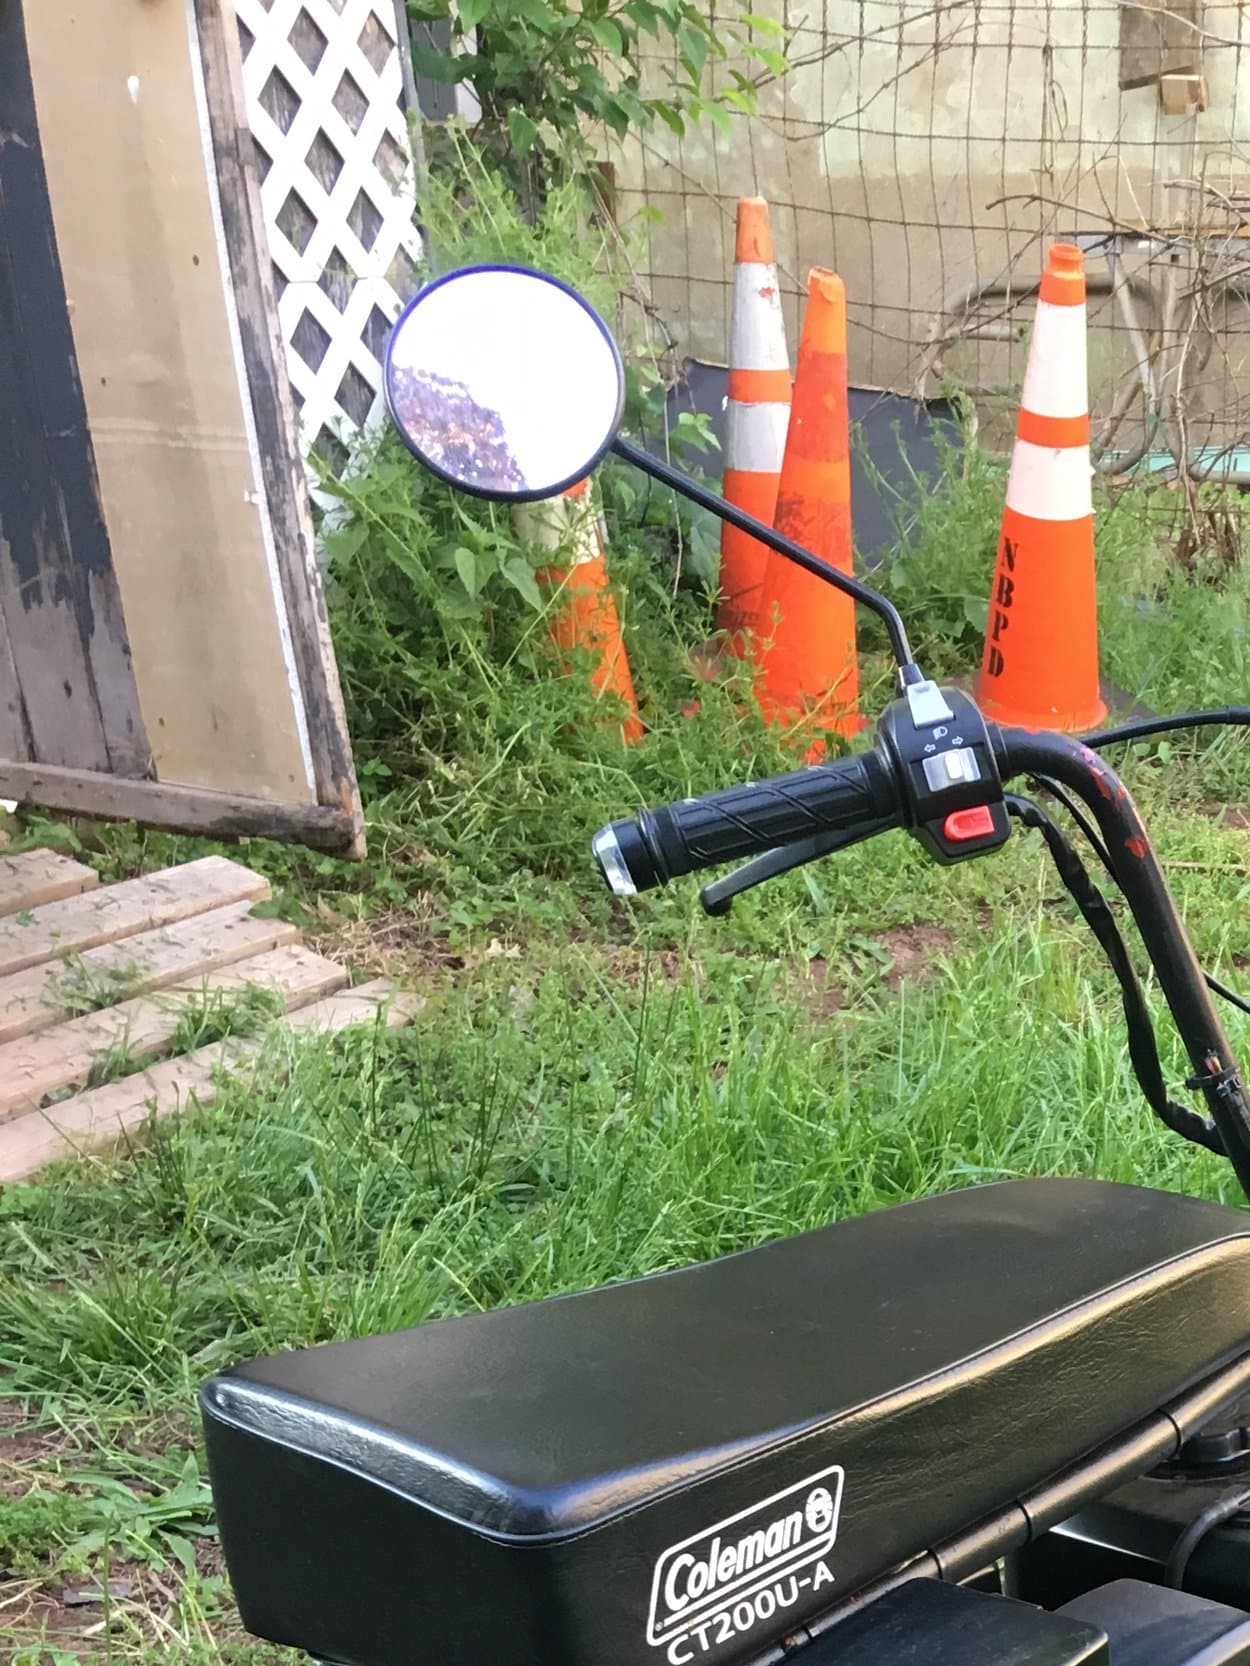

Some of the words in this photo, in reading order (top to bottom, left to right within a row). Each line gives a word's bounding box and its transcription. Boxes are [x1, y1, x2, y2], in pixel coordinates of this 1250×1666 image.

[987, 536, 1019, 678] NBPD
[664, 1511, 803, 1611] Coleman
[667, 1561, 835, 1666] CT200U-A
